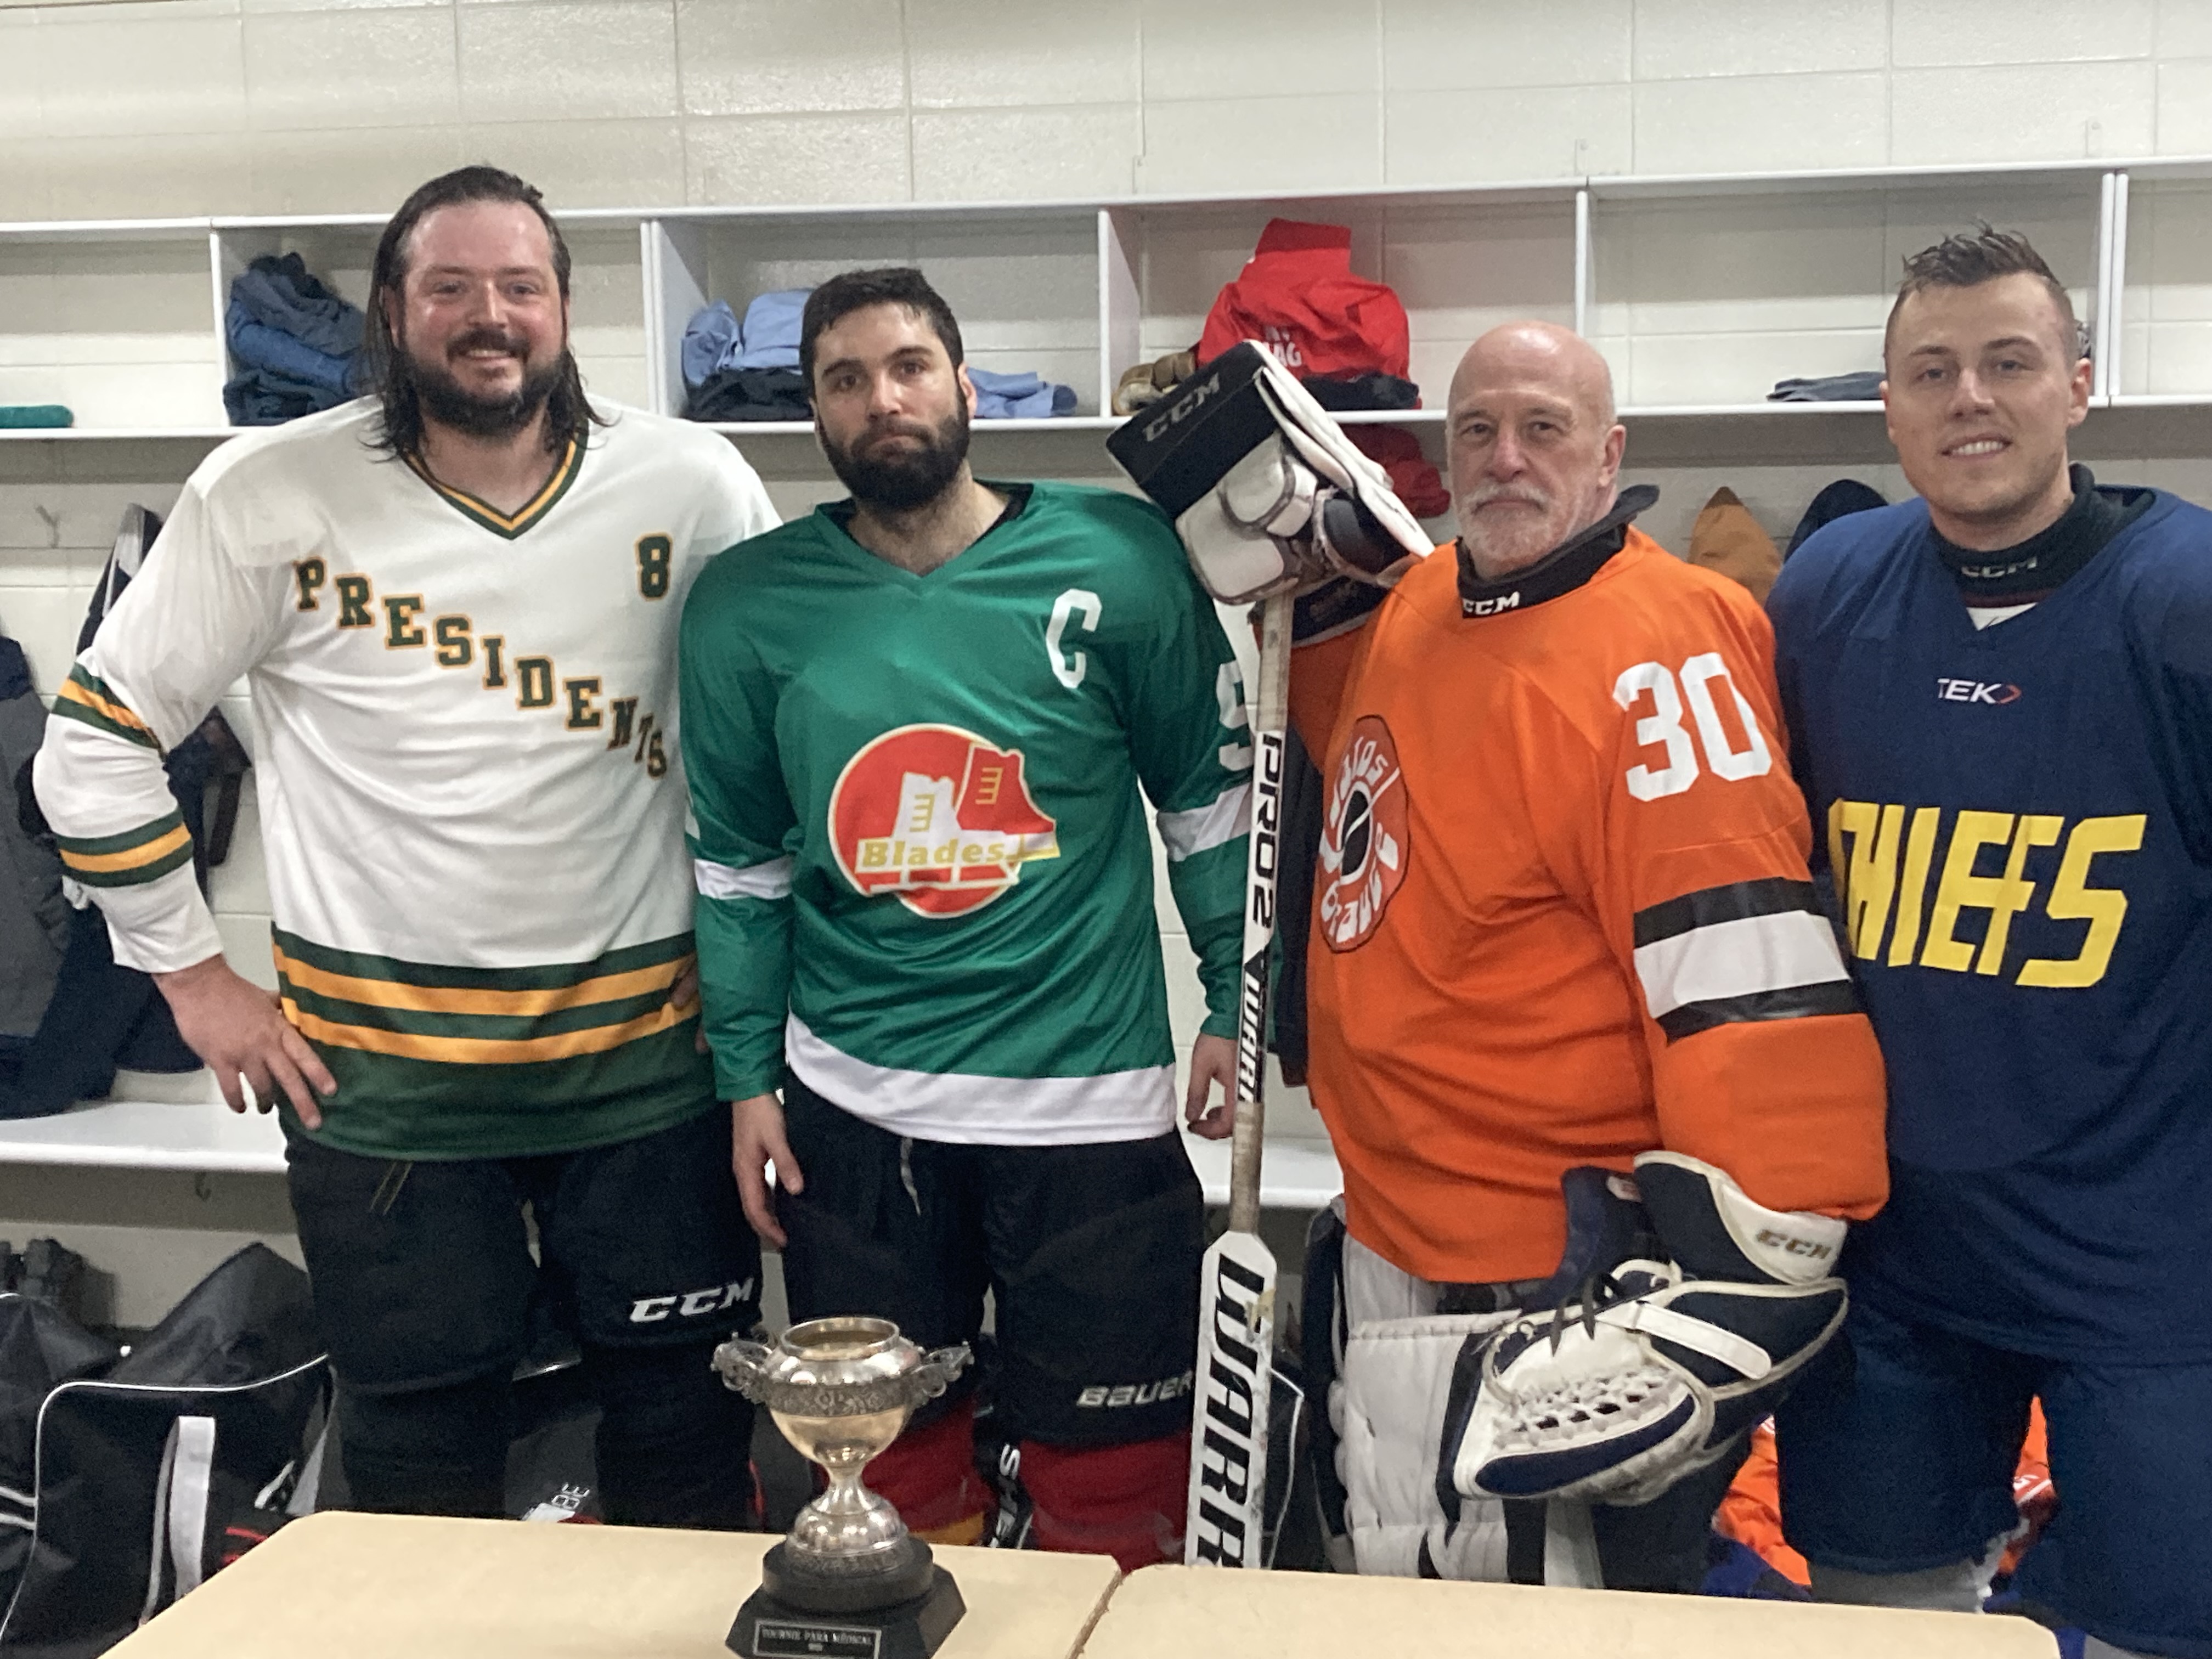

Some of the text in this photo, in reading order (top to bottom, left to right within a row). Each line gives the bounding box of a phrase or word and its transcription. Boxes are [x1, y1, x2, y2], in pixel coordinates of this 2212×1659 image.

[1142, 372, 1220, 442] CCM
[634, 533, 674, 601] 8
[1462, 591, 1520, 615] CCM
[293, 555, 667, 780] PRESIDENTS
[1046, 588, 1103, 689] C
[1612, 652, 1773, 802] 30
[862, 837, 1006, 867] Blades
[1756, 1228, 1832, 1260] CCM
[629, 1276, 754, 1323] CCM
